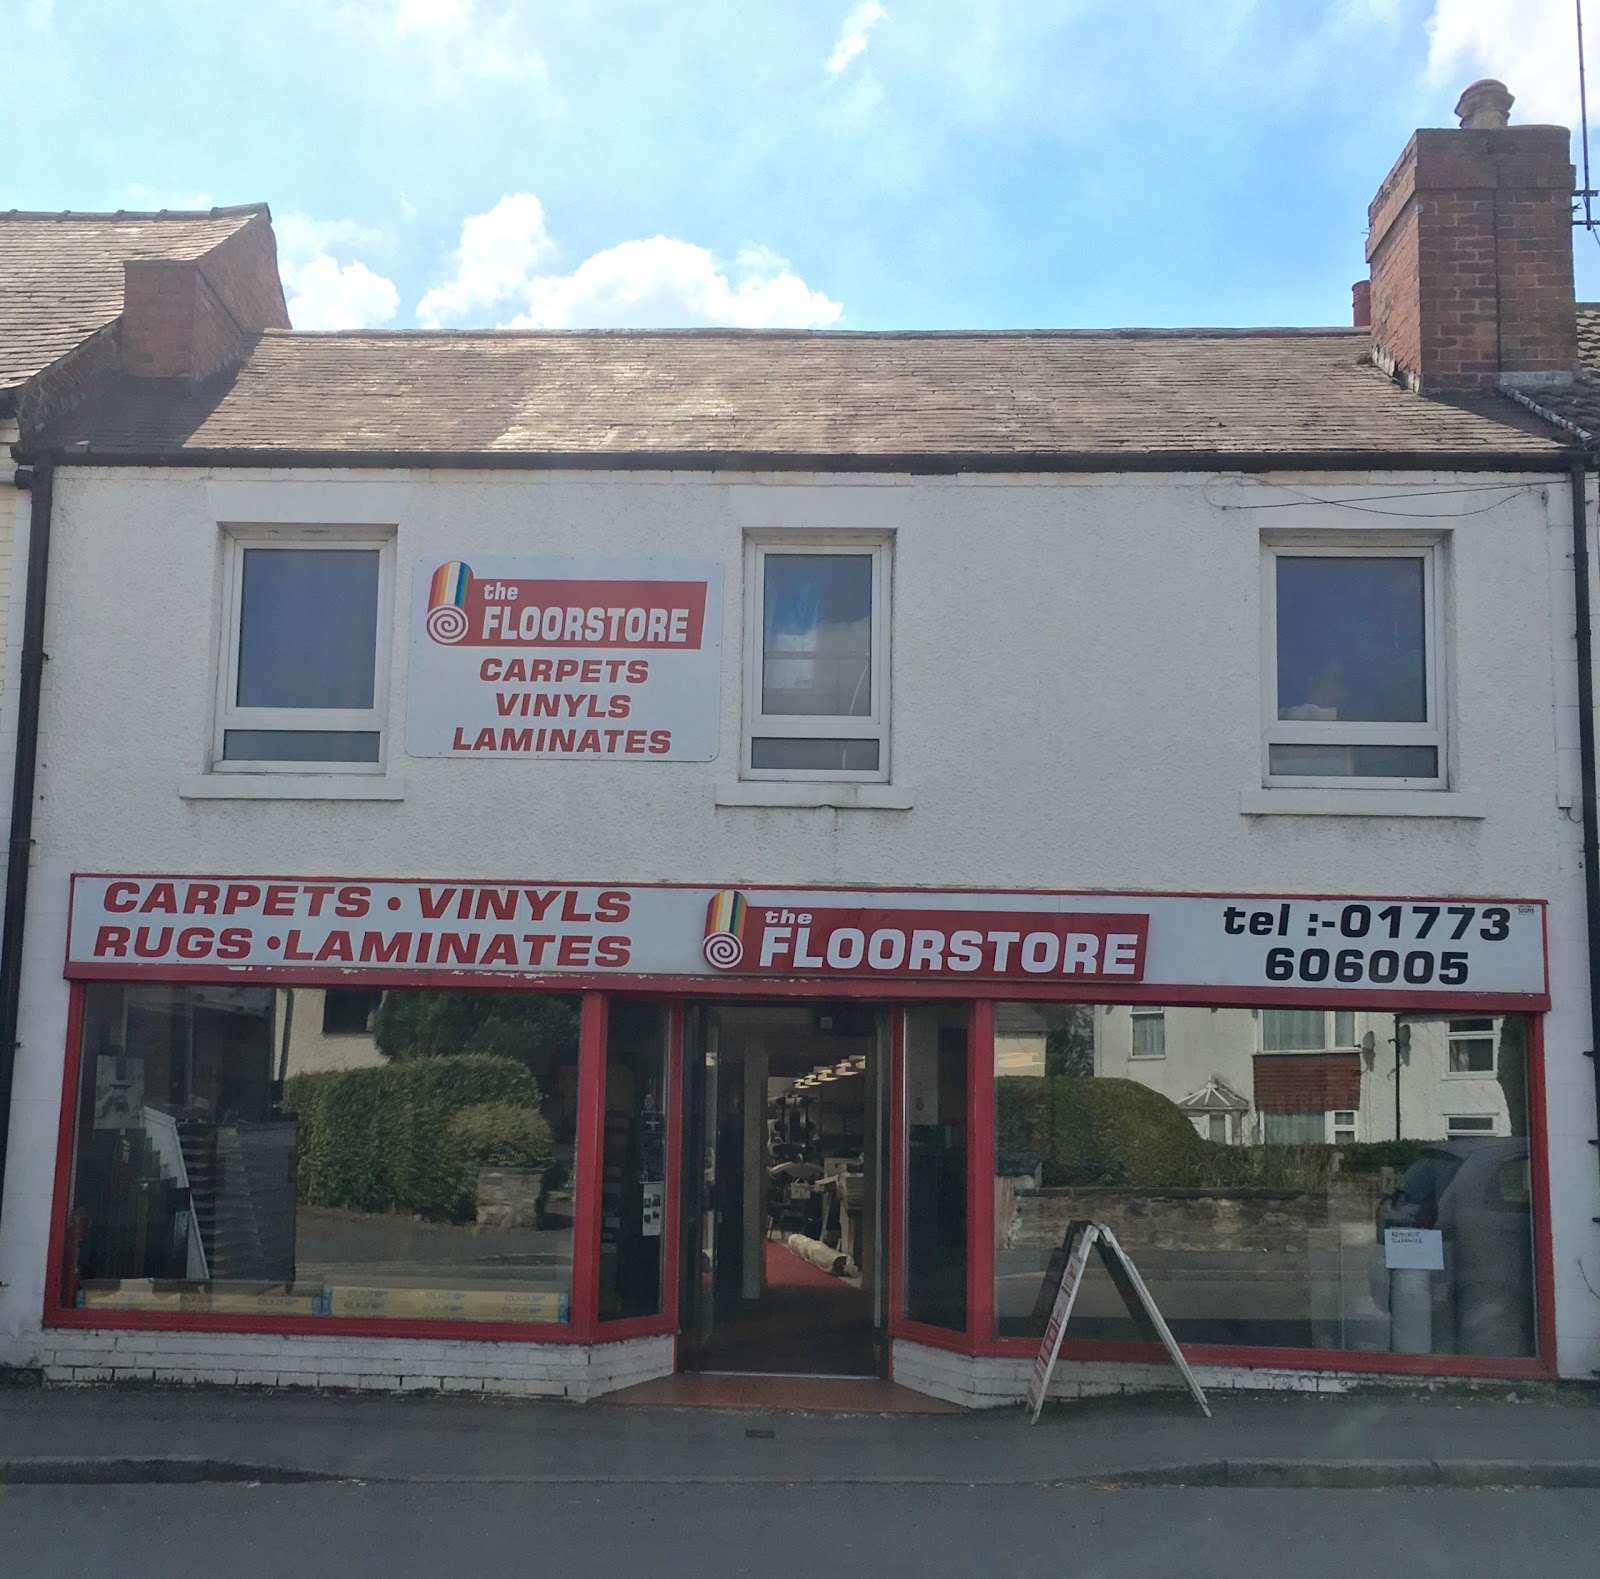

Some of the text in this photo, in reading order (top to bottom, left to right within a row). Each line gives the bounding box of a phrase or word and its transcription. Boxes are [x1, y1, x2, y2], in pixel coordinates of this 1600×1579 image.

[483, 582, 519, 601] the
[481, 605, 689, 643] FLOORSTORE
[480, 658, 649, 684] CARPETS
[495, 693, 631, 719] VINYLS
[453, 727, 671, 754] LAMINATES
[103, 881, 632, 923] CARPETS VINYLS
[764, 908, 812, 925] the
[1223, 903, 1291, 937] tel
[93, 926, 252, 959] RUGS
[758, 926, 1138, 975] FLOORSTORE
[1265, 947, 1469, 985] 606005
